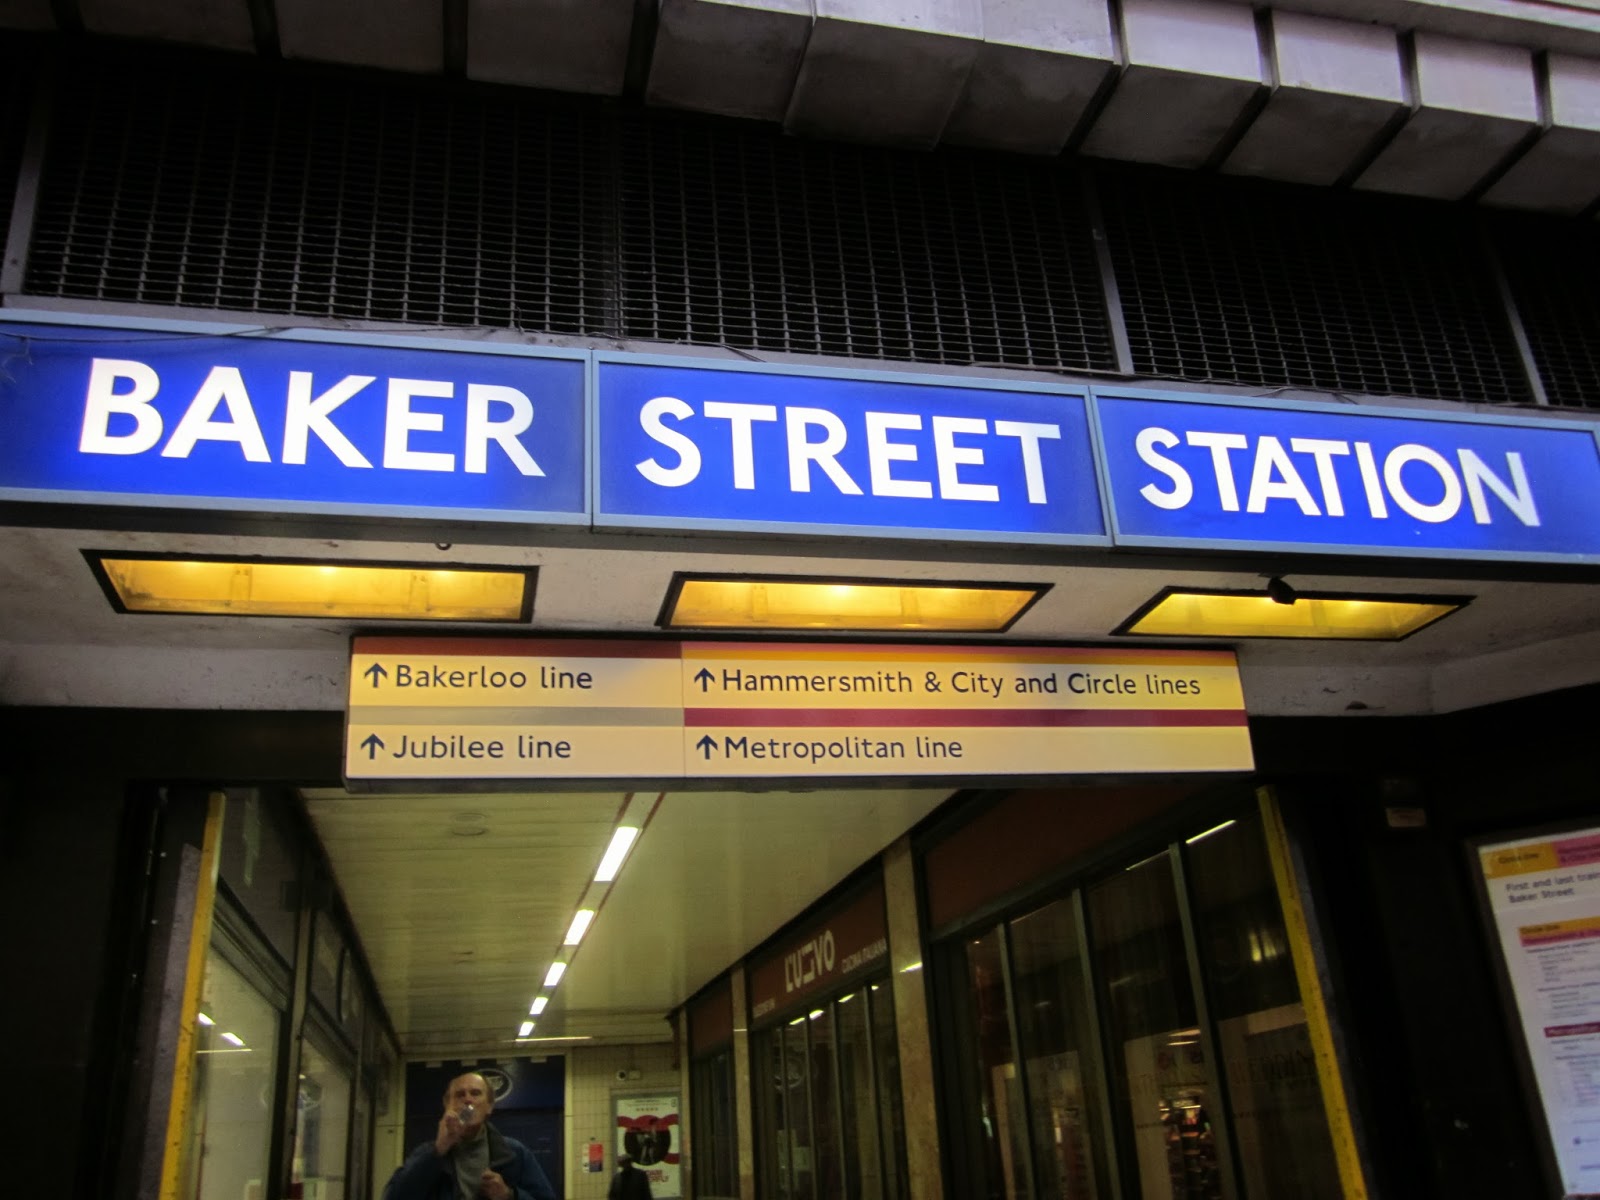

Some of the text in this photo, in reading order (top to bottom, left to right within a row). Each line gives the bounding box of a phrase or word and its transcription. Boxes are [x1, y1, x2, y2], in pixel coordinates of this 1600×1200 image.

[79, 358, 1541, 528] BAKER STREET STATION
[396, 664, 593, 689] Bakerloo line
[722, 668, 1201, 698] Hammersmith & City and Circle lines
[393, 734, 572, 759] Jubilee line
[724, 736, 963, 764] Metropolitan line
[1532, 878, 1552, 888] and
